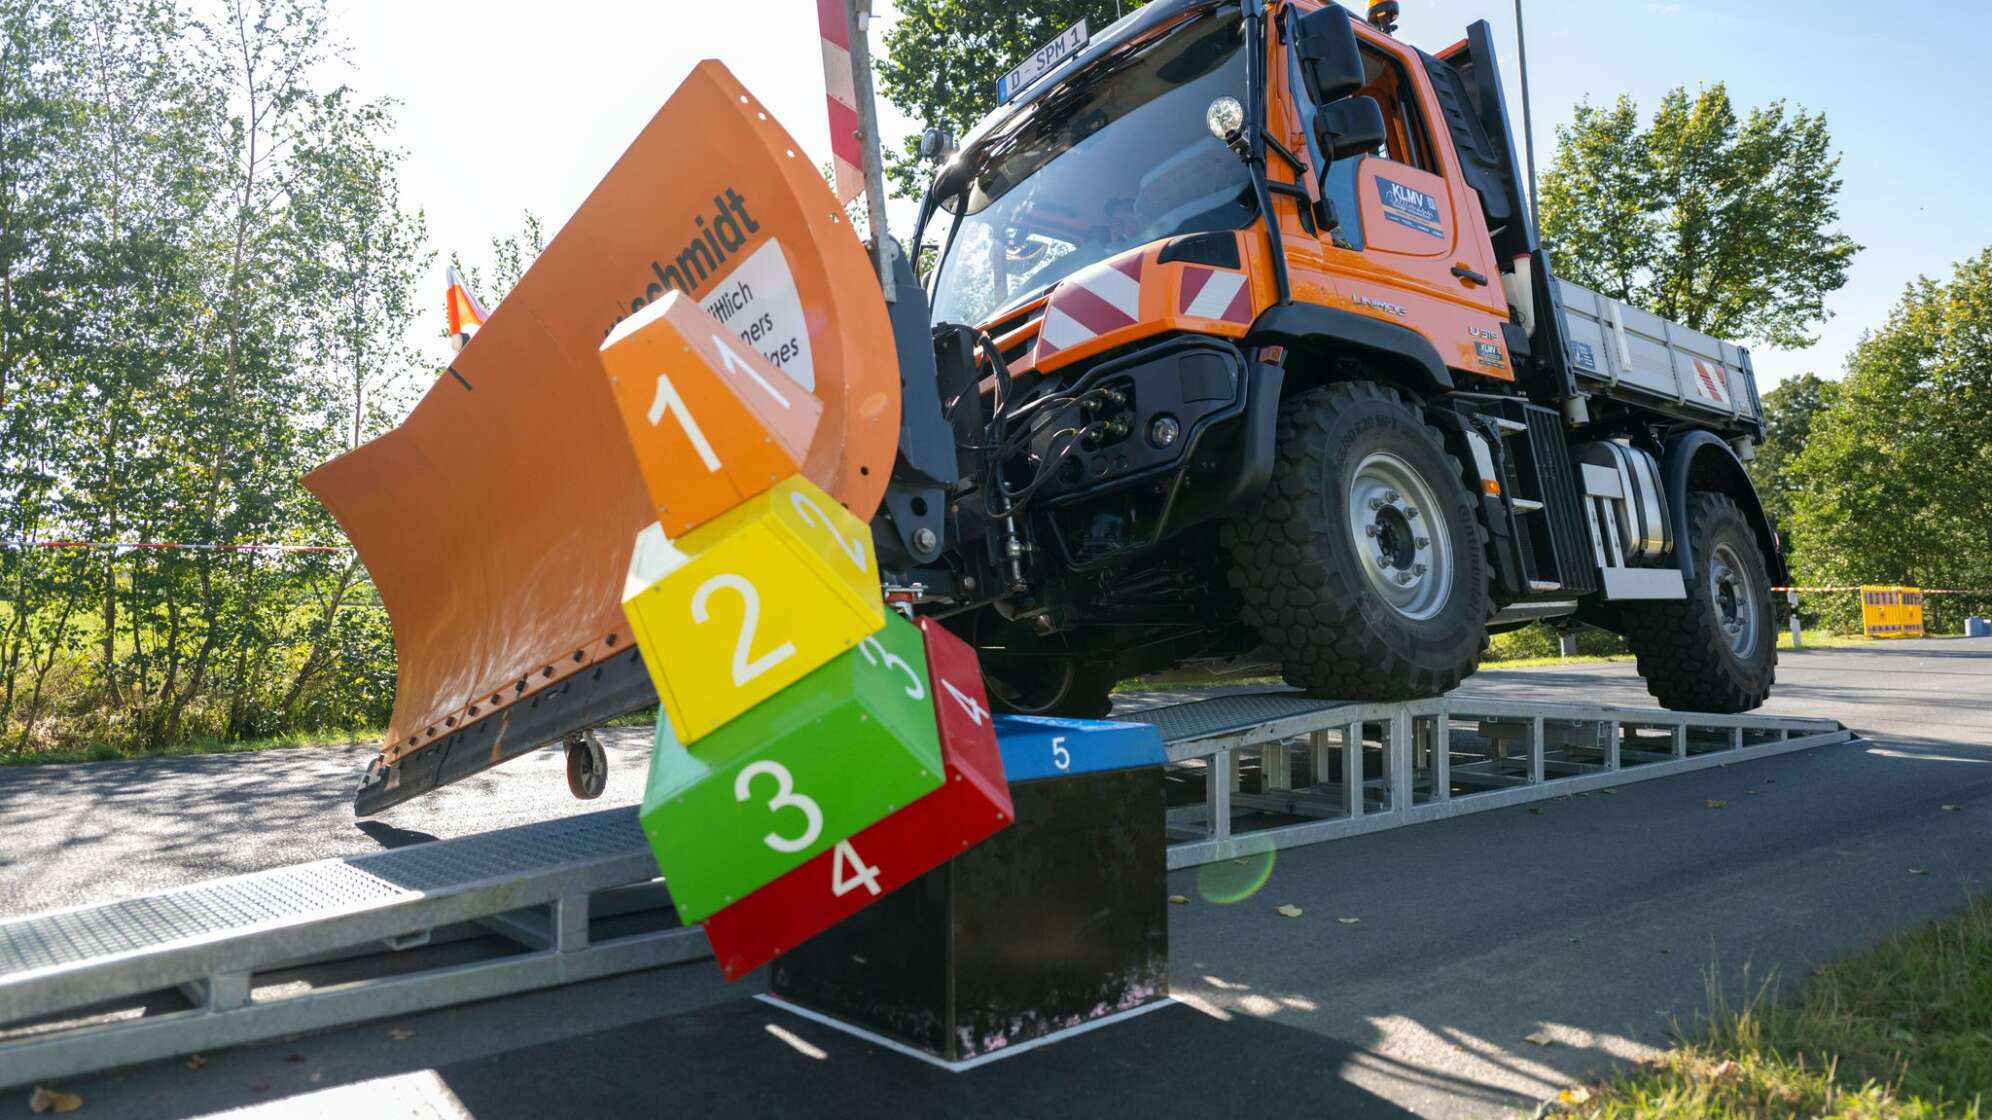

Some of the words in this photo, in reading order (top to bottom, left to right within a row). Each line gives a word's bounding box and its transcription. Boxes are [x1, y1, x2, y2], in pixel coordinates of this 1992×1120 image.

[1010, 70, 1021, 90] D
[1036, 36, 1065, 71] SPM
[1071, 27, 1081, 47] 1
[1391, 183, 1423, 207] KLMV
[712, 334, 791, 410] 1
[648, 374, 722, 472] 1
[790, 491, 868, 574] 2
[691, 573, 797, 687] 2
[858, 636, 925, 701] 3
[940, 678, 990, 728] 4
[1052, 736, 1071, 769] 5
[734, 759, 824, 853] 3
[832, 838, 882, 897] 4
